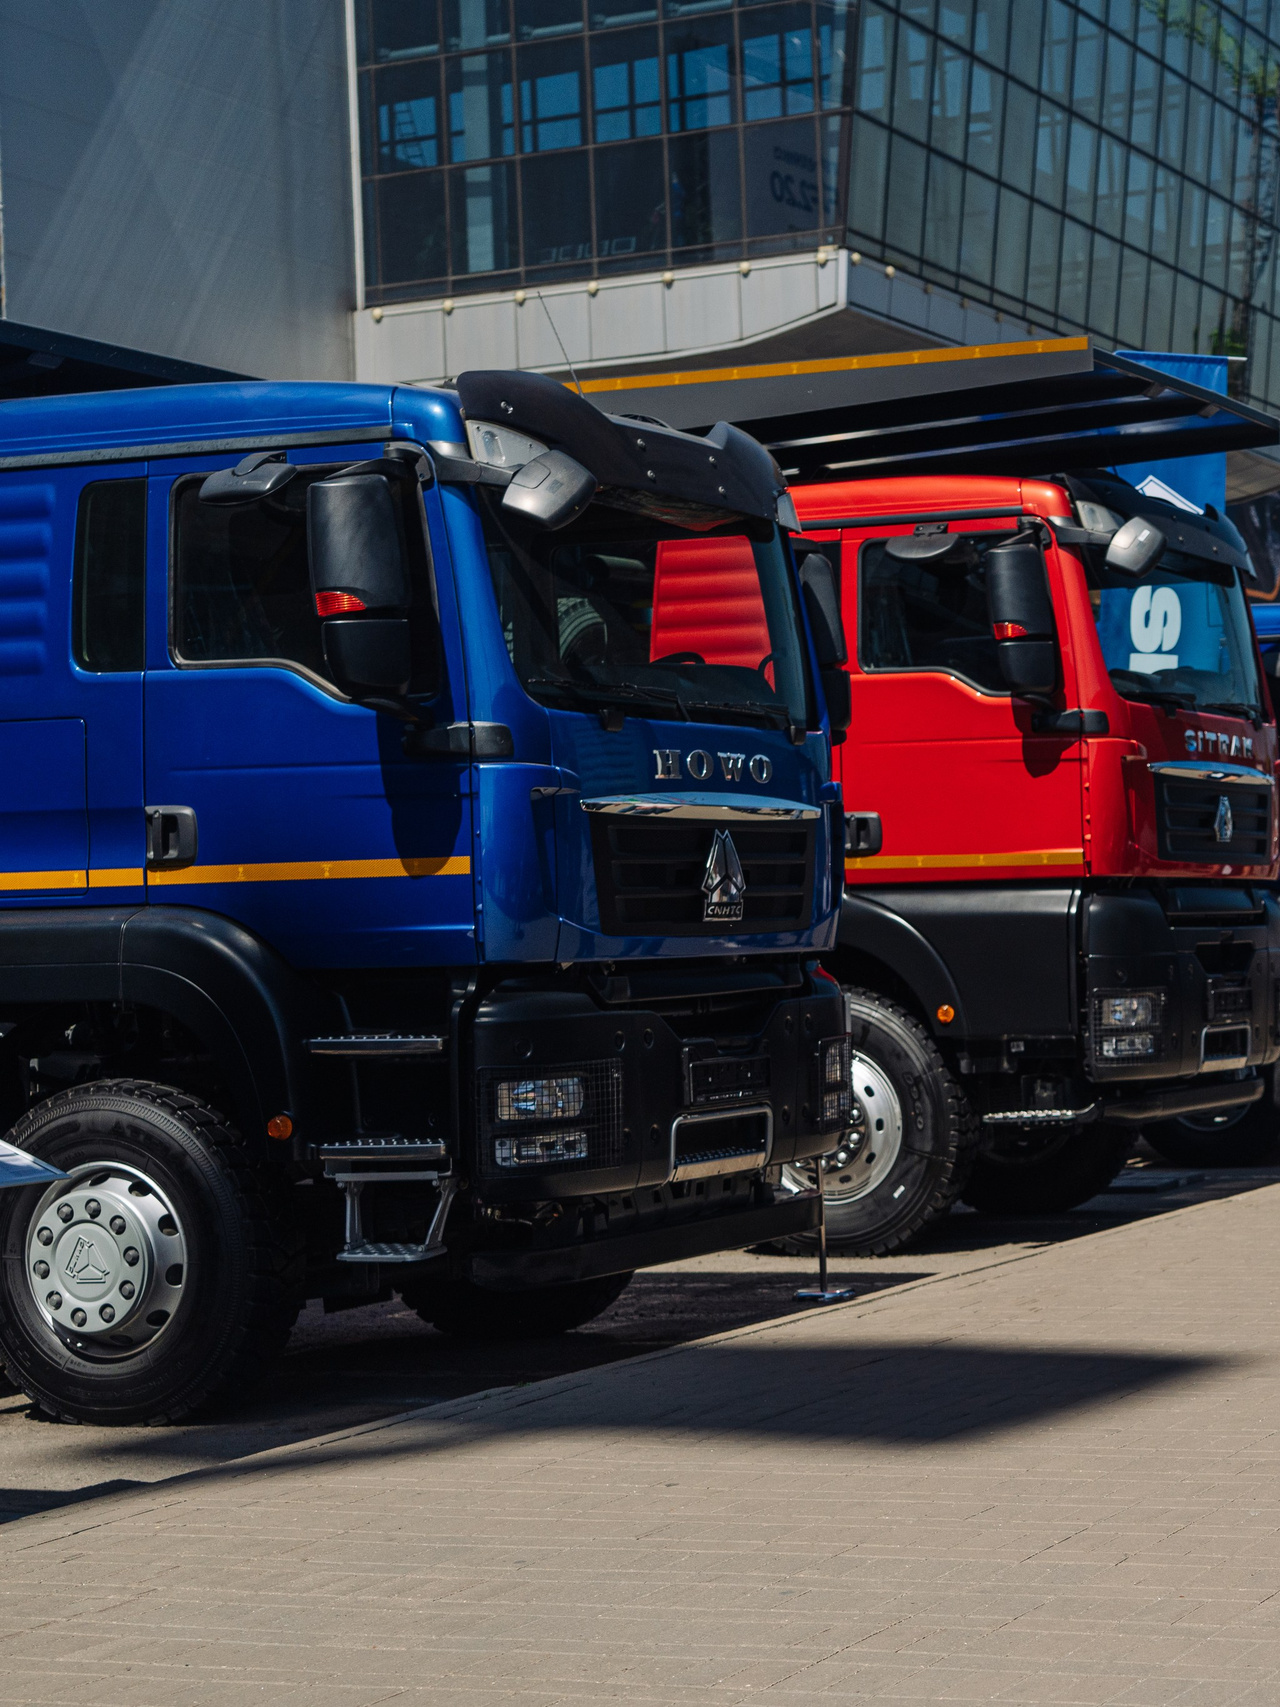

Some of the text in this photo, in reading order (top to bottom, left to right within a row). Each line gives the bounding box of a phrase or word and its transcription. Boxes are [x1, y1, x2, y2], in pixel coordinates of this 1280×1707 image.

[1184, 729, 1254, 760] SITRAK
[652, 749, 773, 784] HOWO
[707, 905, 741, 915] CNHTC
